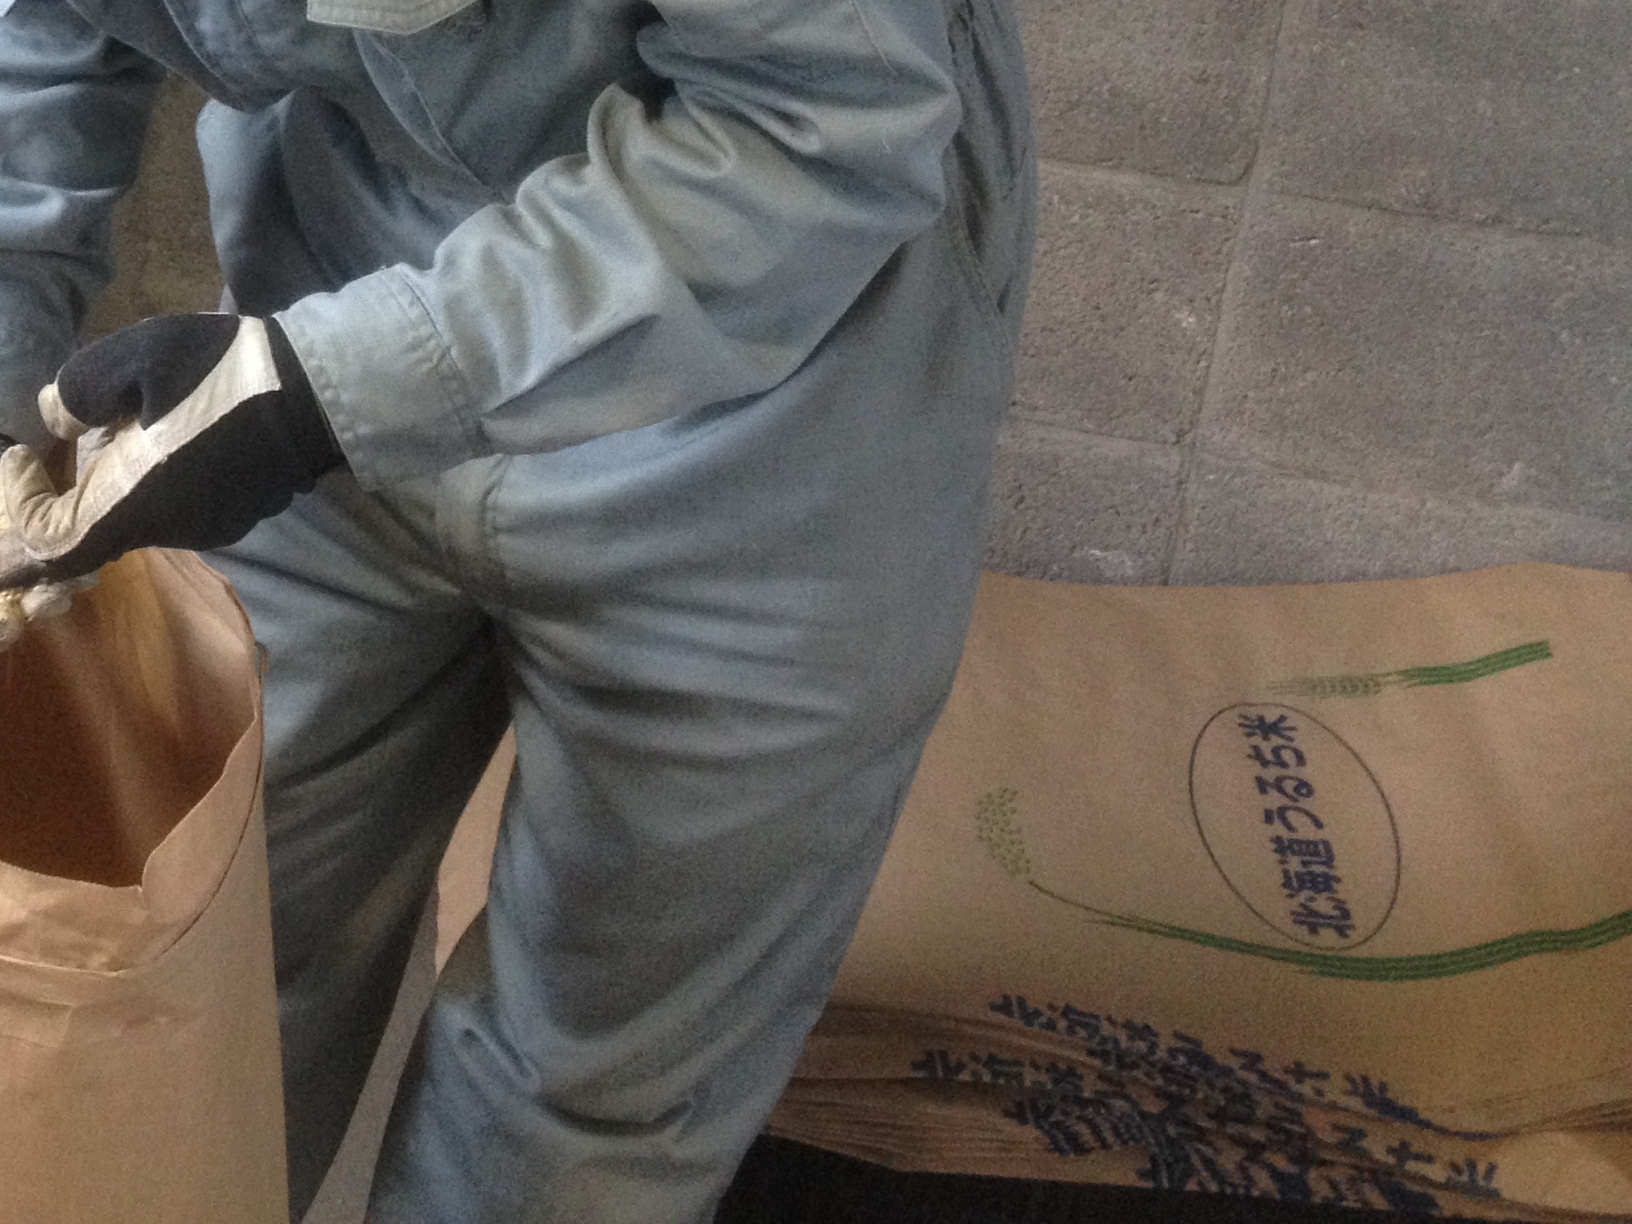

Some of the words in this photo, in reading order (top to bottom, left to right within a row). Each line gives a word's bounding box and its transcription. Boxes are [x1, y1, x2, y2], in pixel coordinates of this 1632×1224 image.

[1236, 711, 1357, 940] 北海道うるち米
